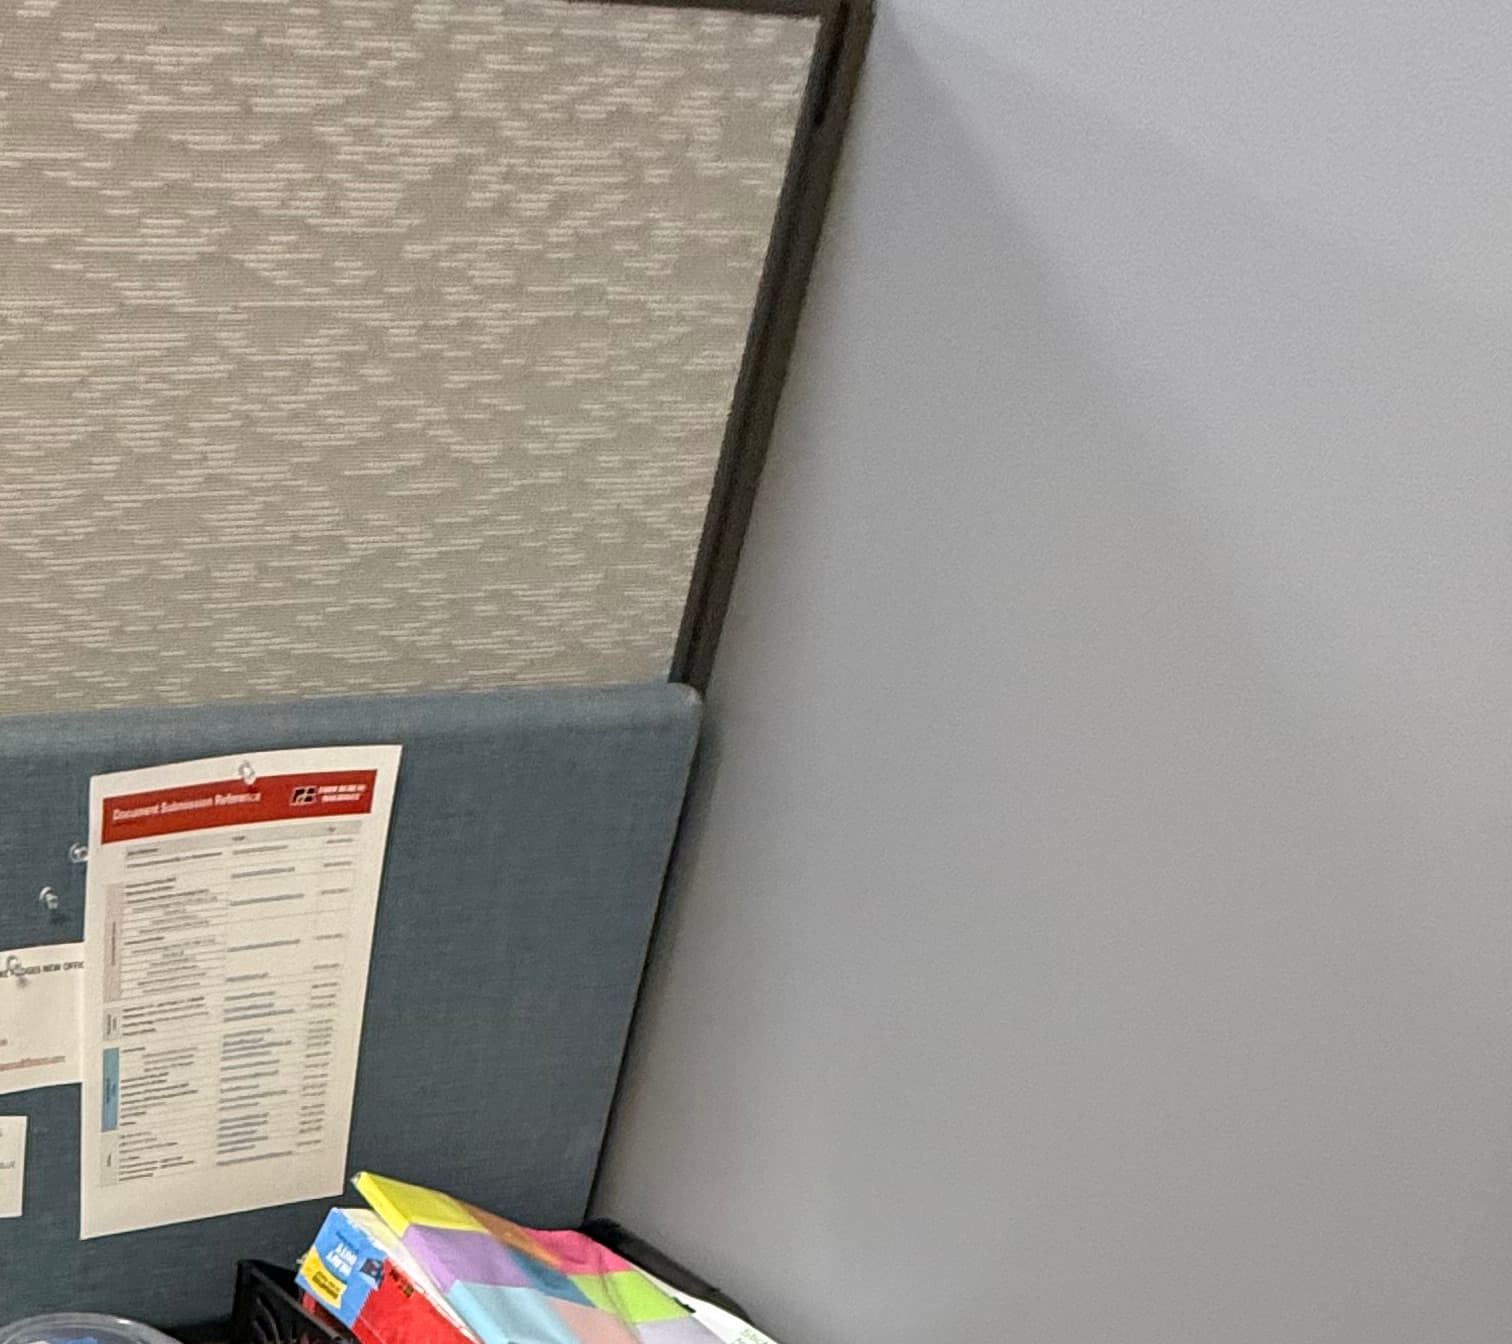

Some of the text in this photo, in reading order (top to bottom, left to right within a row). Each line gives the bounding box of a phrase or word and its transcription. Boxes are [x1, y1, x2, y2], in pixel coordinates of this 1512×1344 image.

[112, 804, 159, 821] Document
[215, 791, 261, 806] Reference
[43, 964, 61, 972] NEW
[63, 961, 84, 970] OFFIC
